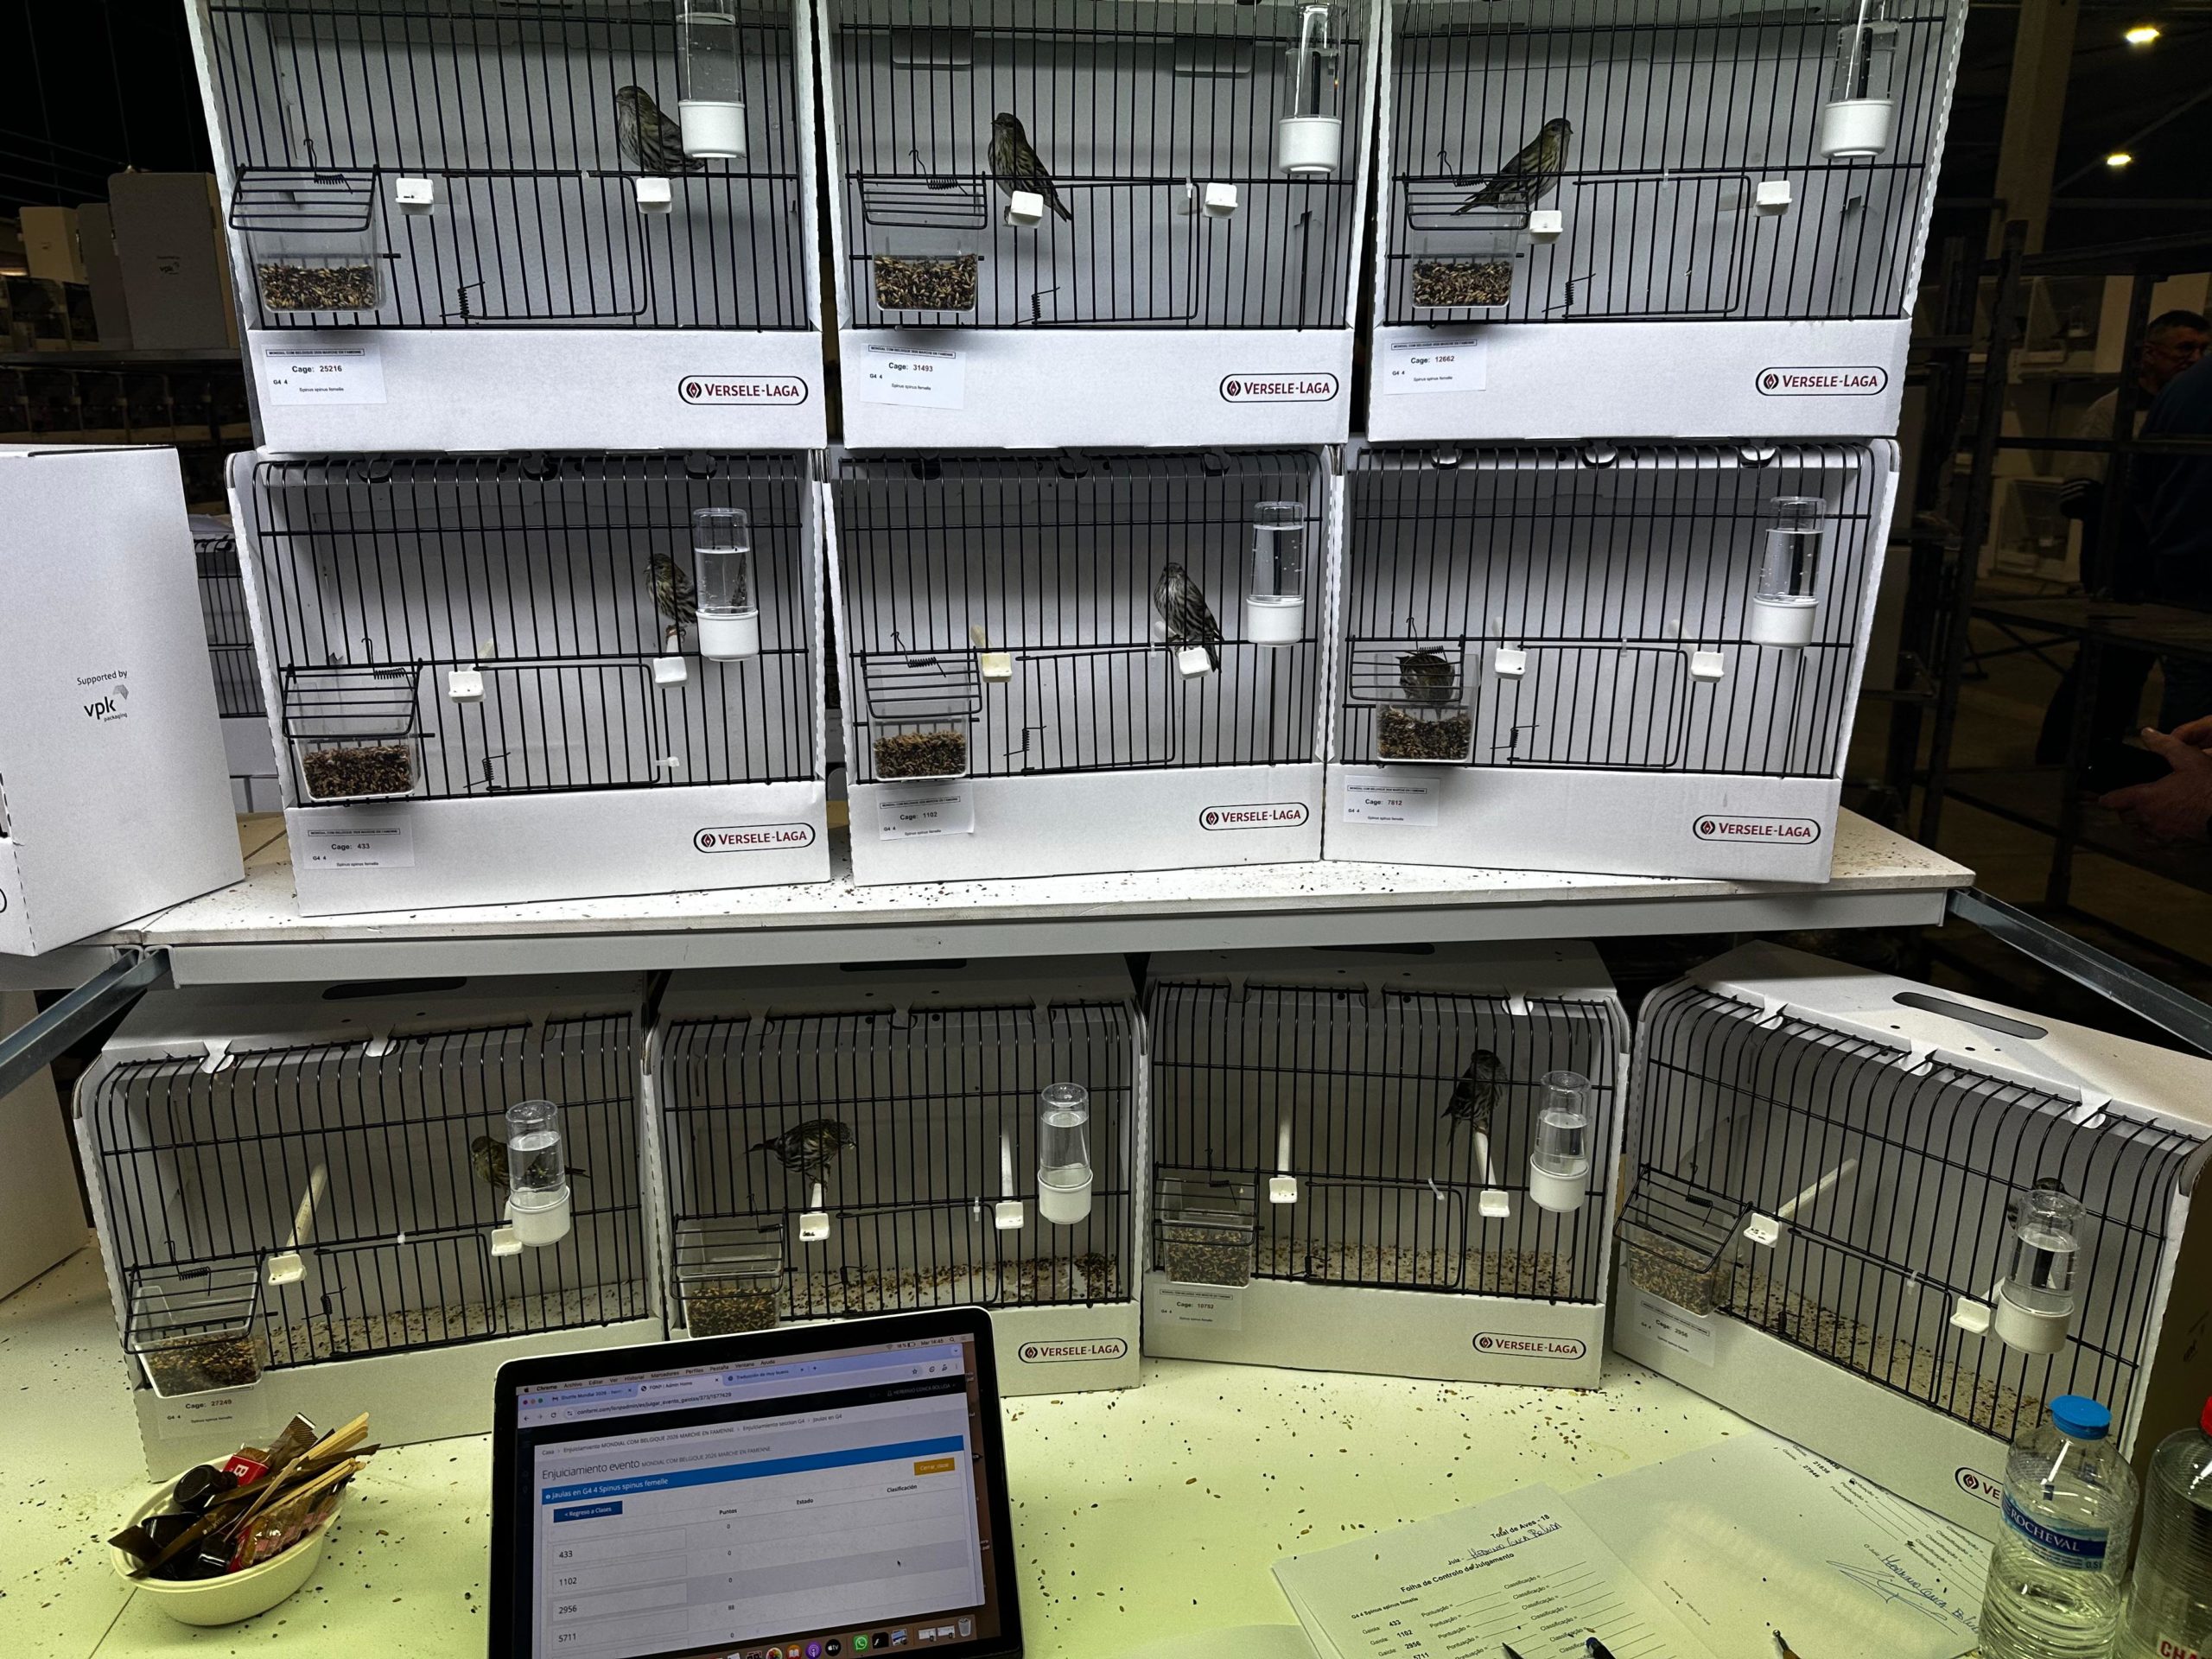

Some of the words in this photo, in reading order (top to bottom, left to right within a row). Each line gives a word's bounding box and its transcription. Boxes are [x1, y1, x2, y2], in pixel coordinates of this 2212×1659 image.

[888, 362, 908, 371] Cage:
[912, 364, 933, 372] 31493
[1783, 375, 1878, 387] VERSELE-LAGA
[704, 384, 799, 397] VERSELE-LAGA
[1244, 382, 1330, 394] VERSELE-LAGA
[77, 671, 117, 685] Supported
[118, 670, 128, 679] by
[84, 696, 116, 720] vpk
[104, 712, 128, 721] packaging
[1222, 810, 1300, 822] VERSELE-LAGA
[1719, 823, 1811, 837] VERSELE-LAGA
[718, 831, 807, 844] VERSELE-LAGA
[1040, 1344, 1120, 1357] VERSELE-LAGA
[1496, 1338, 1578, 1354] VERSELE-LAGA
[640, 1435, 665, 1444] BELGIQUE
[542, 1463, 607, 1480] Enjuiciamiento
[609, 1459, 640, 1471] evento
[679, 1453, 704, 1463] BELGIQUE
[551, 1491, 572, 1500] Jaulas
[599, 1484, 621, 1494] Spinus
[622, 1481, 644, 1491] spinus
[645, 1478, 669, 1487] femelle
[887, 1484, 918, 1493] Clasificación
[1490, 1529, 1509, 1540] Total
[1519, 1520, 1536, 1529] Aves
[2011, 1509, 2080, 1552] ROCHEVAL
[559, 1550, 573, 1559] 433
[1401, 1582, 1421, 1593] Folha
[1432, 1568, 1464, 1583] Controlo
[1474, 1552, 1515, 1570] Julgamento
[560, 1577, 577, 1586] 1102
[1421, 1605, 1449, 1618] Pontuação
[1504, 1575, 1537, 1589] Classificação
[558, 1605, 577, 1614] 2956
[1363, 1607, 1382, 1616] Spinus
[1400, 1597, 1419, 1605] femelle
[1396, 1630, 1414, 1638] 1102
[1429, 1615, 1458, 1628] Pontuação
[1513, 1586, 1546, 1599] Classificação
[1404, 1641, 1421, 1649] 2956
[1438, 1626, 1466, 1639] Pontuação
[1522, 1596, 1554, 1610] Classificação
[1446, 1637, 1475, 1650] Pontuação
[1530, 1606, 1564, 1620] Classificação
[1540, 1617, 1574, 1630] Classificação
[558, 1633, 576, 1643] 5711
